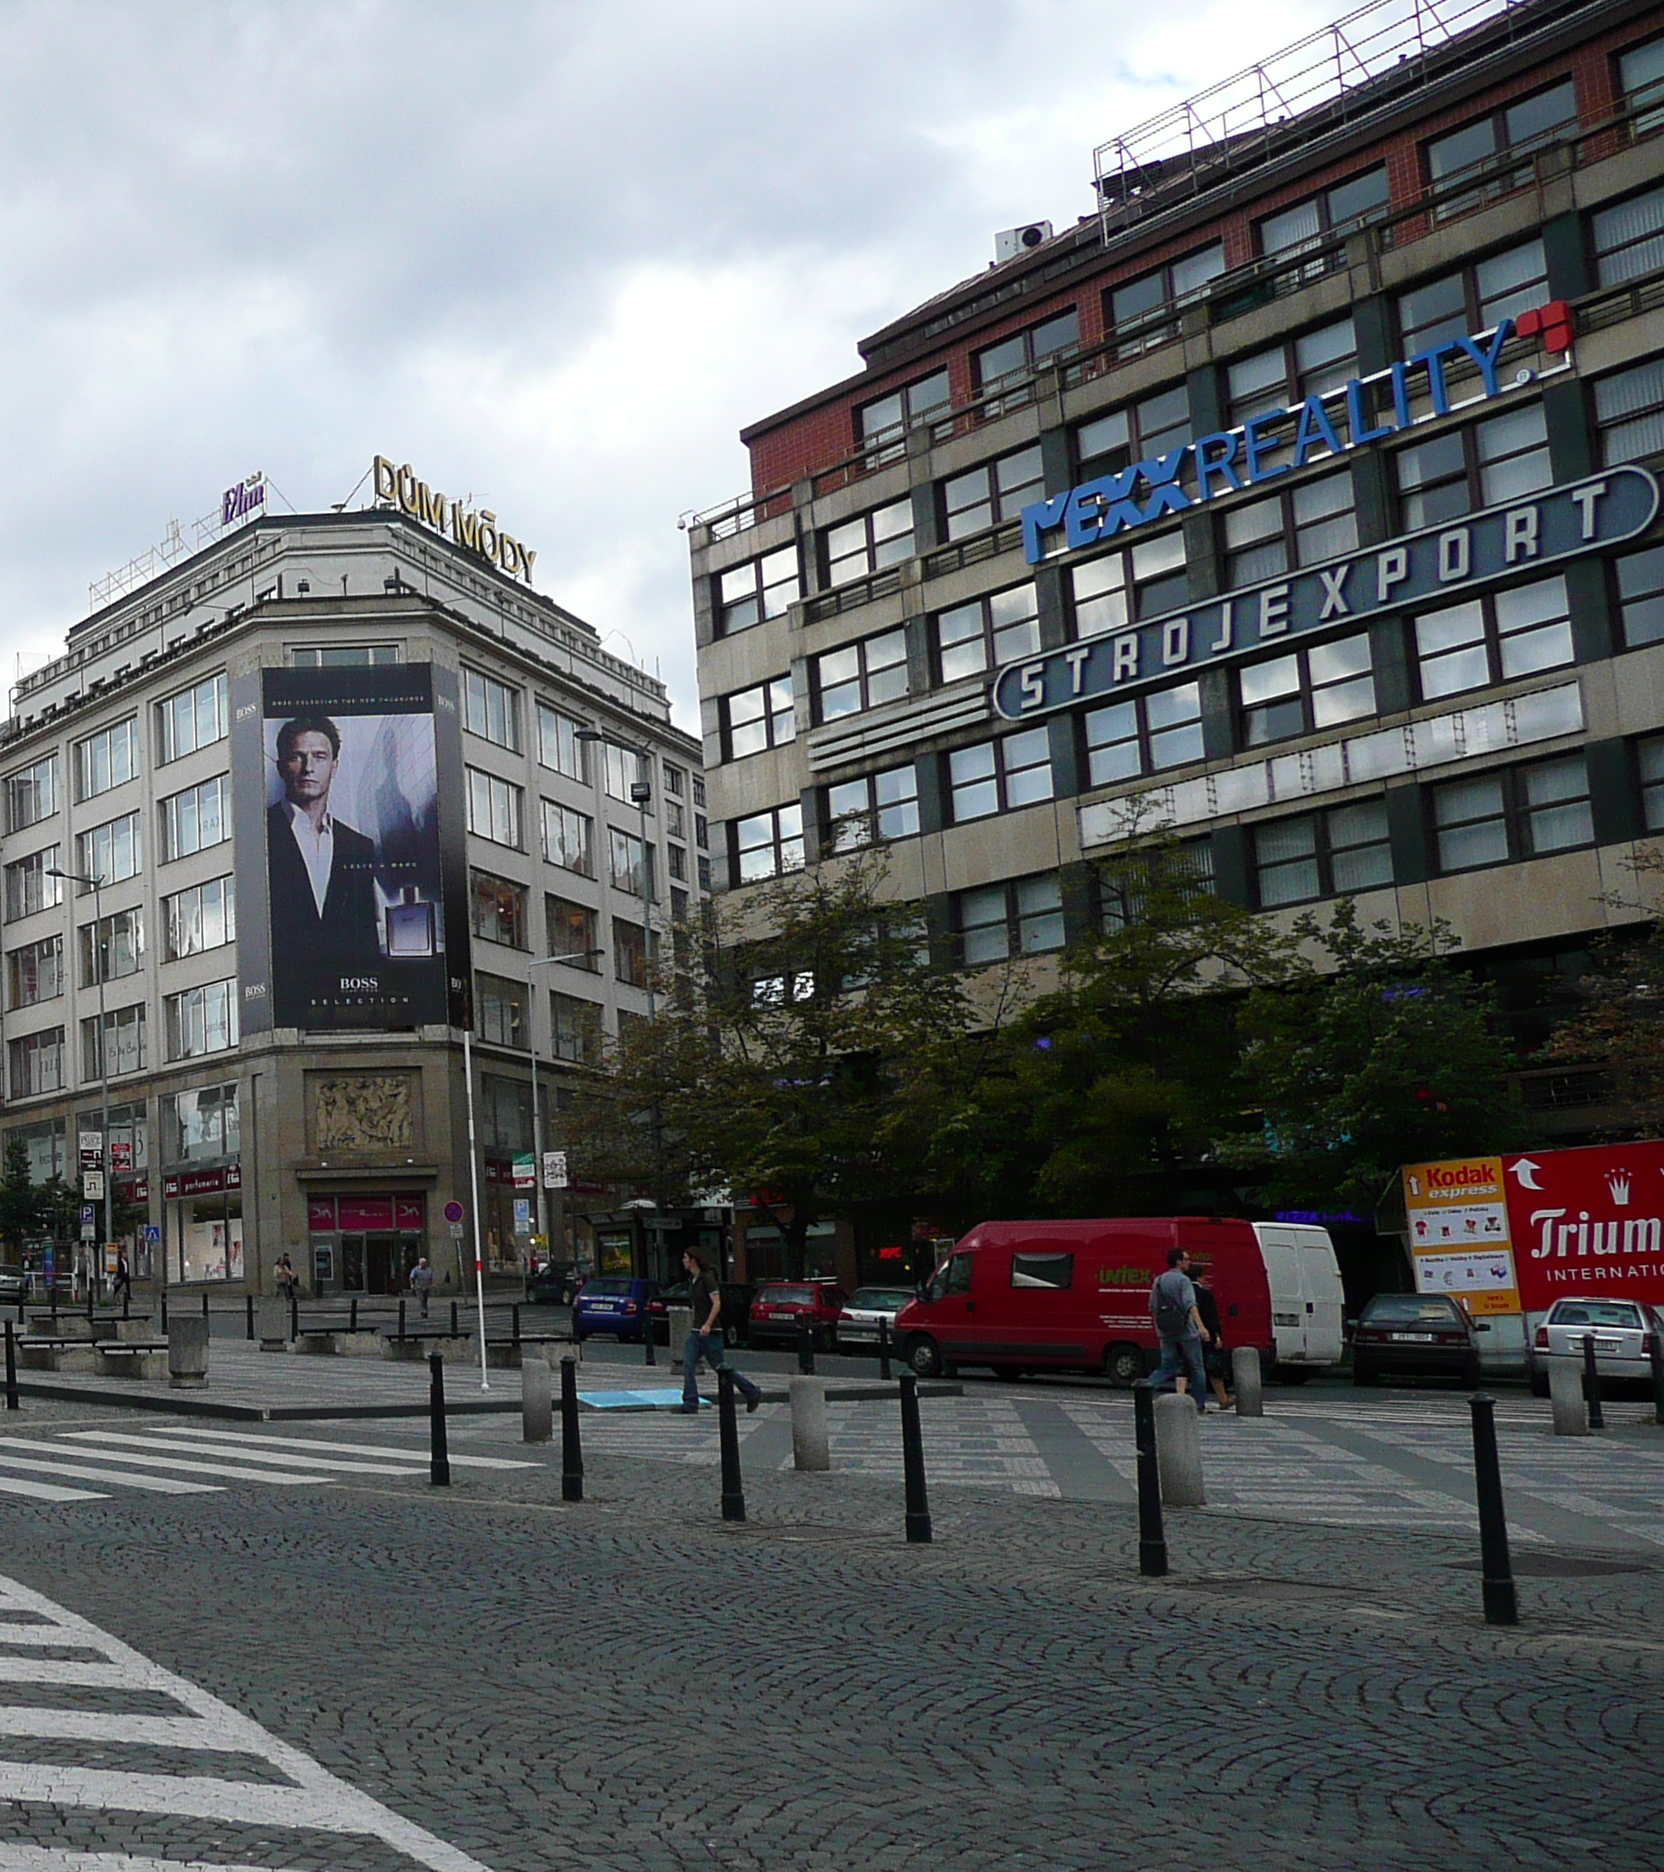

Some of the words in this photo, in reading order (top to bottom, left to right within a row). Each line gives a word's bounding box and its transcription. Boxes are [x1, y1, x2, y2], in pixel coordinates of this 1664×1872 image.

[1019, 480, 1608, 711] STROJEXPORT
[236, 703, 256, 719] BOSS
[245, 983, 266, 997] BOSS
[340, 977, 378, 990] BOSS
[311, 997, 409, 1006] SELECTION
[1426, 1164, 1496, 1188] Kodak
[1428, 1184, 1499, 1199] express
[83, 1207, 92, 1219] P
